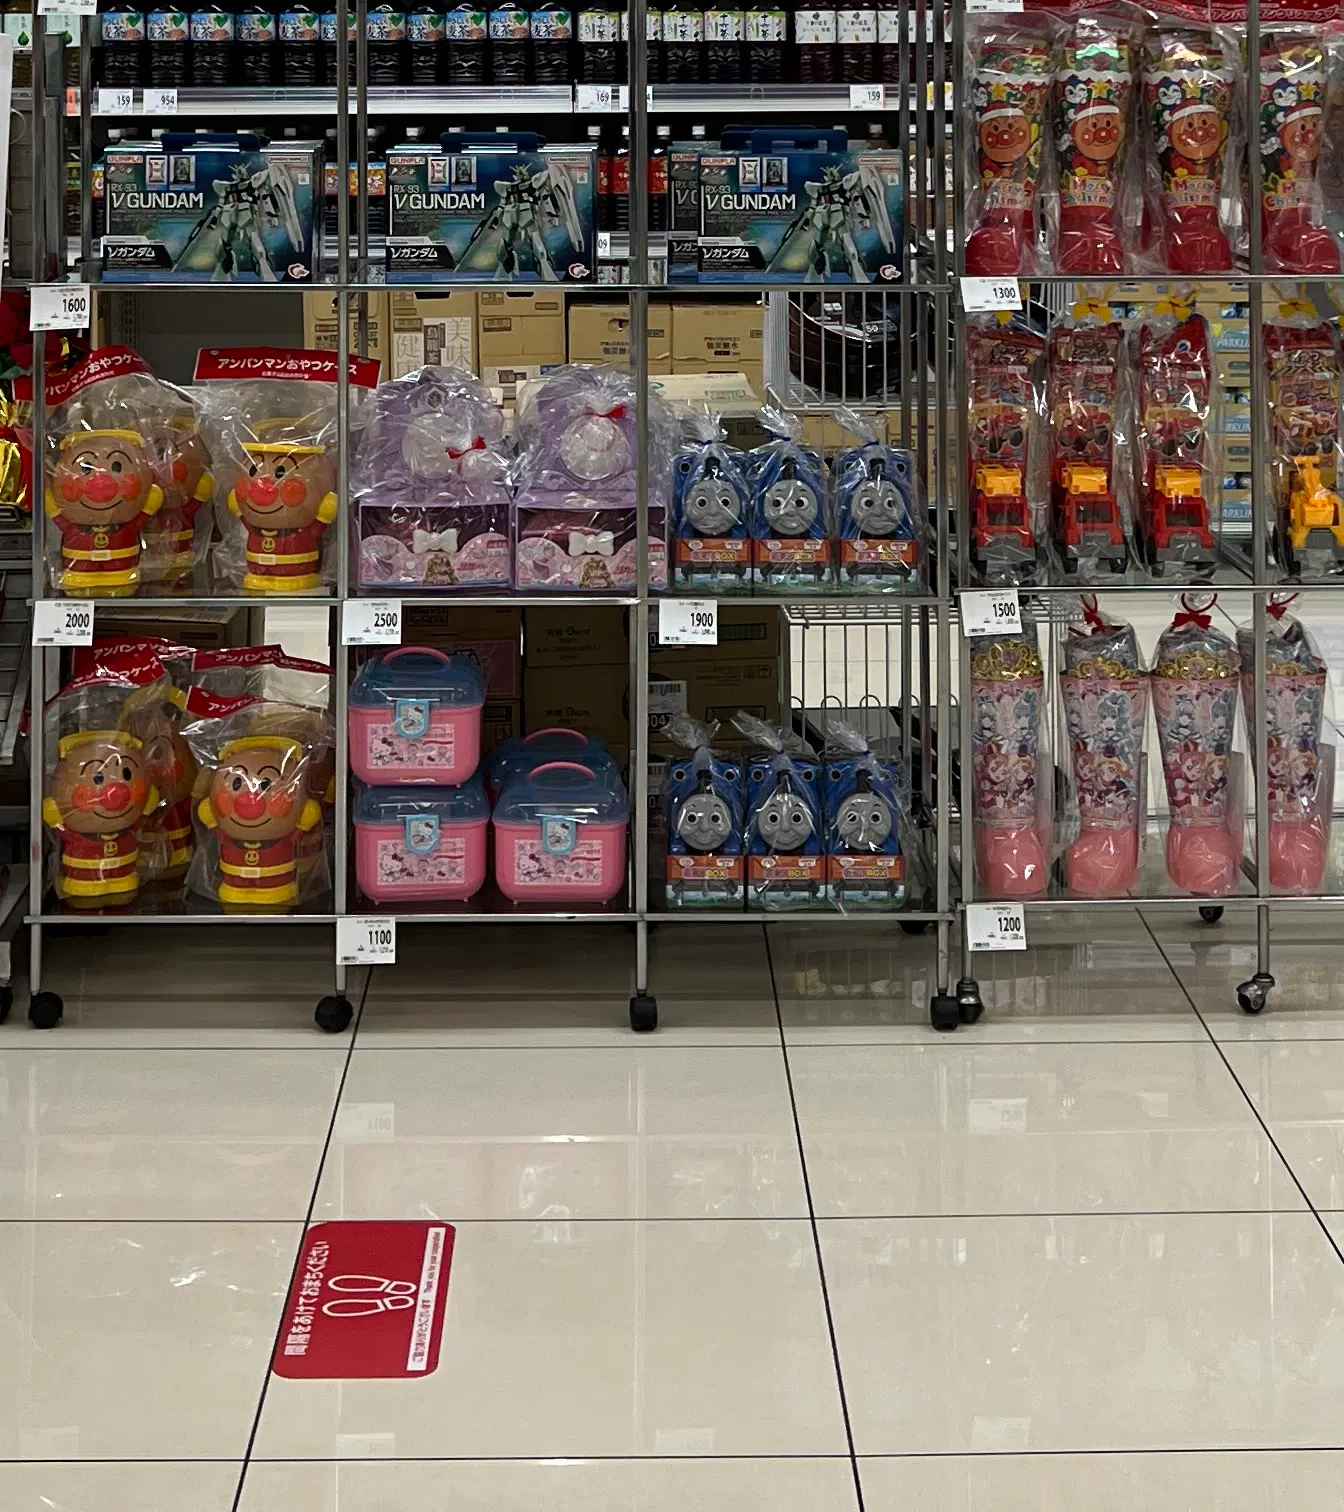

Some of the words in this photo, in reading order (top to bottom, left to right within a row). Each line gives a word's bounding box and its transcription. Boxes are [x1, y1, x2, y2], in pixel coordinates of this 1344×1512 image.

[117, 95, 131, 106] 159
[160, 95, 175, 105] 954
[867, 90, 881, 101] 159
[126, 192, 204, 209] GUNDAM
[409, 193, 485, 209] GUNDAM
[720, 193, 796, 210] GUNDAM
[992, 287, 1016, 300] 1300
[62, 297, 87, 313] 1600
[992, 602, 1016, 618] 1500
[66, 613, 90, 628] 2000
[374, 612, 398, 628] 2500
[690, 612, 713, 627] 1900
[998, 916, 1022, 932] 1200
[368, 930, 392, 945] 1100
